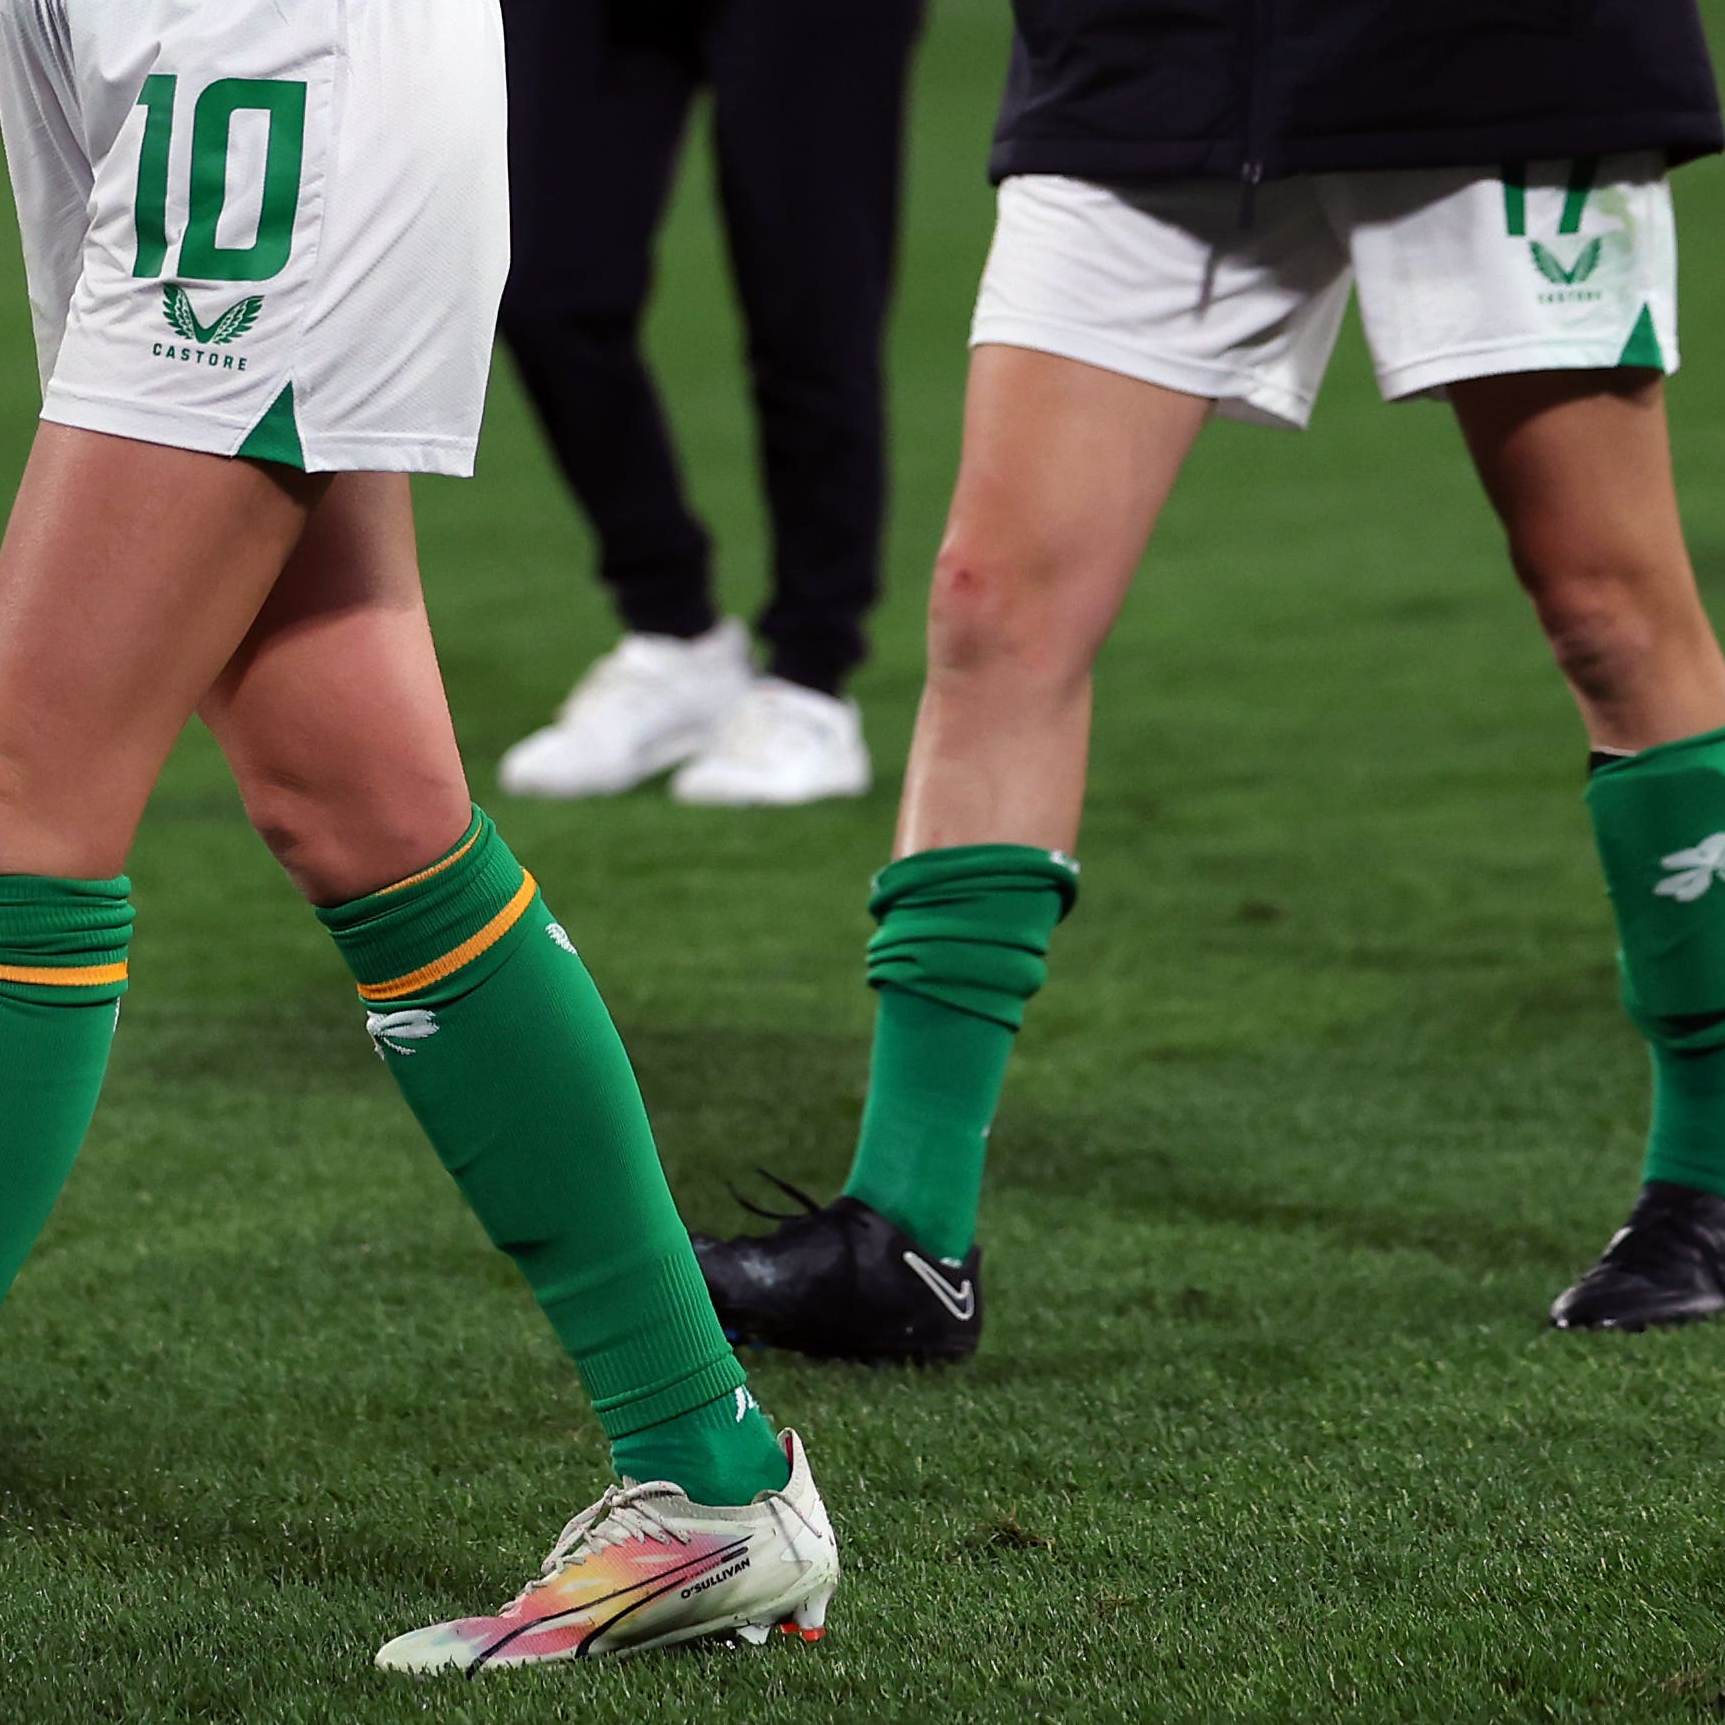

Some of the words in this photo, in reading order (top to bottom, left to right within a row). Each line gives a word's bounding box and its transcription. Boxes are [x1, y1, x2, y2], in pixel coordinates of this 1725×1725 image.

[132, 73, 308, 282] 10
[152, 342, 248, 372] CASTORE
[680, 1557, 751, 1600] O'SULLIVAN
